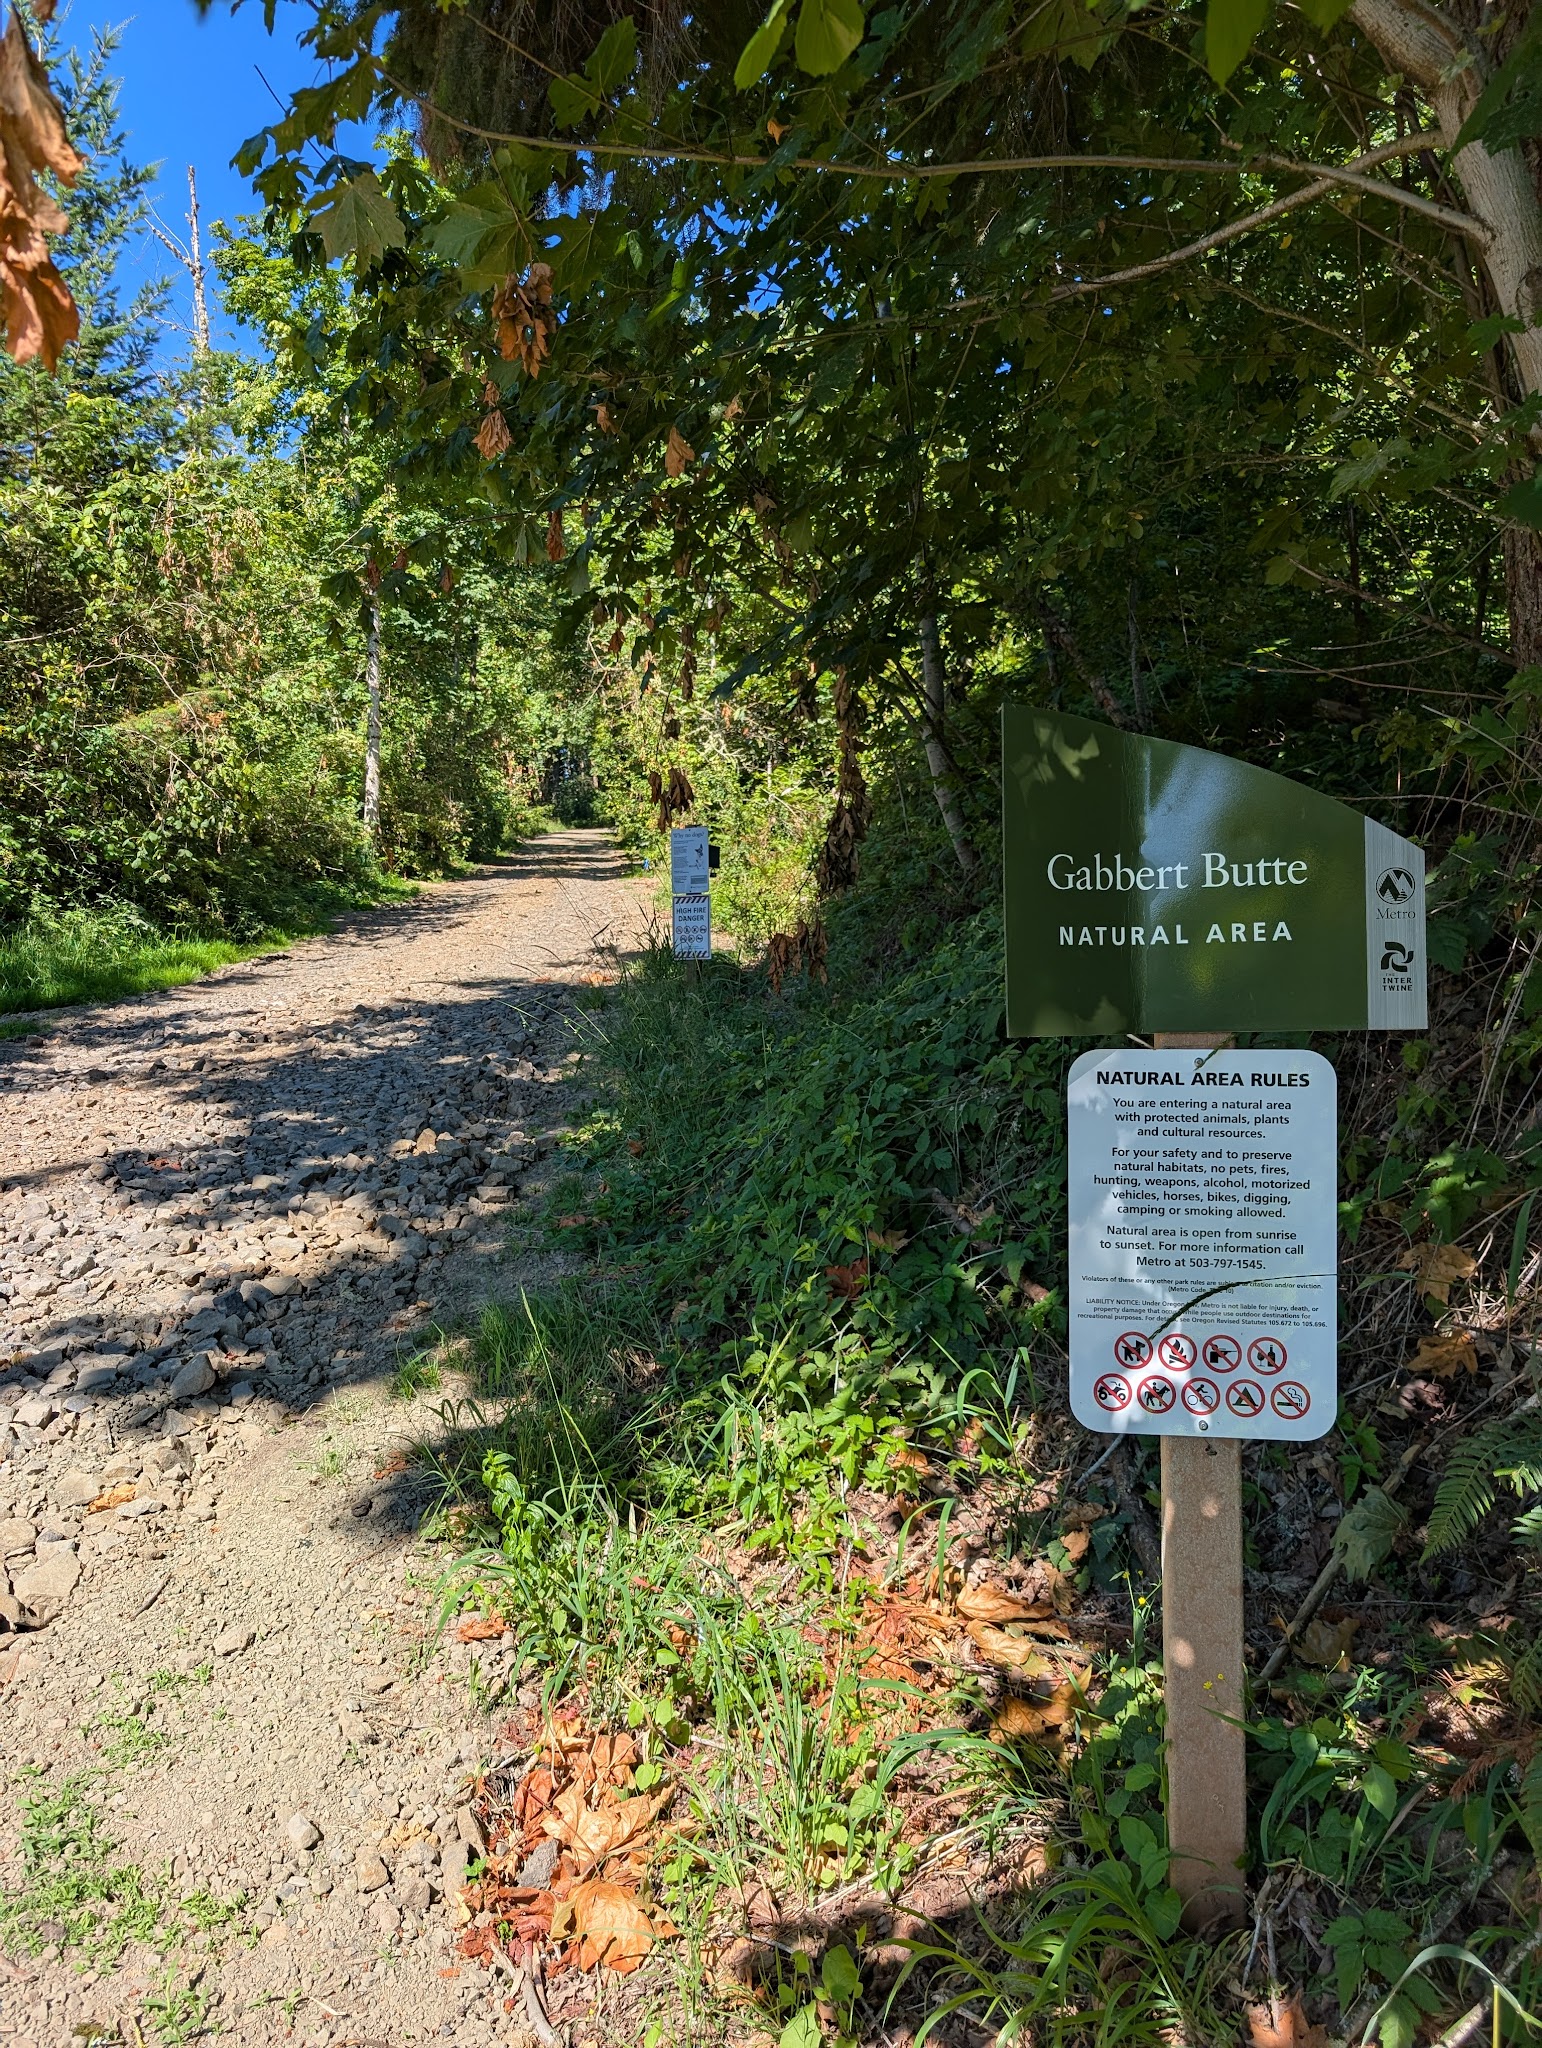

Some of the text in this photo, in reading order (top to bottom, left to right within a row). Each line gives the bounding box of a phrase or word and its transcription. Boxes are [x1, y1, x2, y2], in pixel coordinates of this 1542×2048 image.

[1047, 852, 1307, 890] Gabbert Butte
[1376, 908, 1415, 919] Metro
[1059, 922, 1292, 946] NATURAL AREA
[1097, 1071, 1309, 1087] NATURAL AREA RULES
[1113, 1098, 1135, 1108] You
[1138, 1100, 1156, 1108] are
[1159, 1099, 1207, 1110] entering
[1222, 1100, 1262, 1110] natural
[1266, 1102, 1292, 1110] area
[1115, 1112, 1290, 1126] with protected animals, plants
[1137, 1127, 1266, 1139] and cultural resources.
[1112, 1148, 1292, 1161] For your safety and to preserve
[1114, 1162, 1290, 1175] natural habitats, no pets, fires,
[1093, 1176, 1310, 1189] hunting, weapons, alcohol, motorized
[1112, 1190, 1291, 1205] vehicles, horses, bikes, digging,
[1117, 1205, 1165, 1216] camping
[1184, 1206, 1233, 1218] smoking
[1236, 1207, 1286, 1218] allowed.
[1107, 1226, 1296, 1240] Natural area is open from sunrise
[1100, 1240, 1304, 1254] to sunset. For more information call
[1137, 1256, 1266, 1270] Metro at 503-797-1545.
